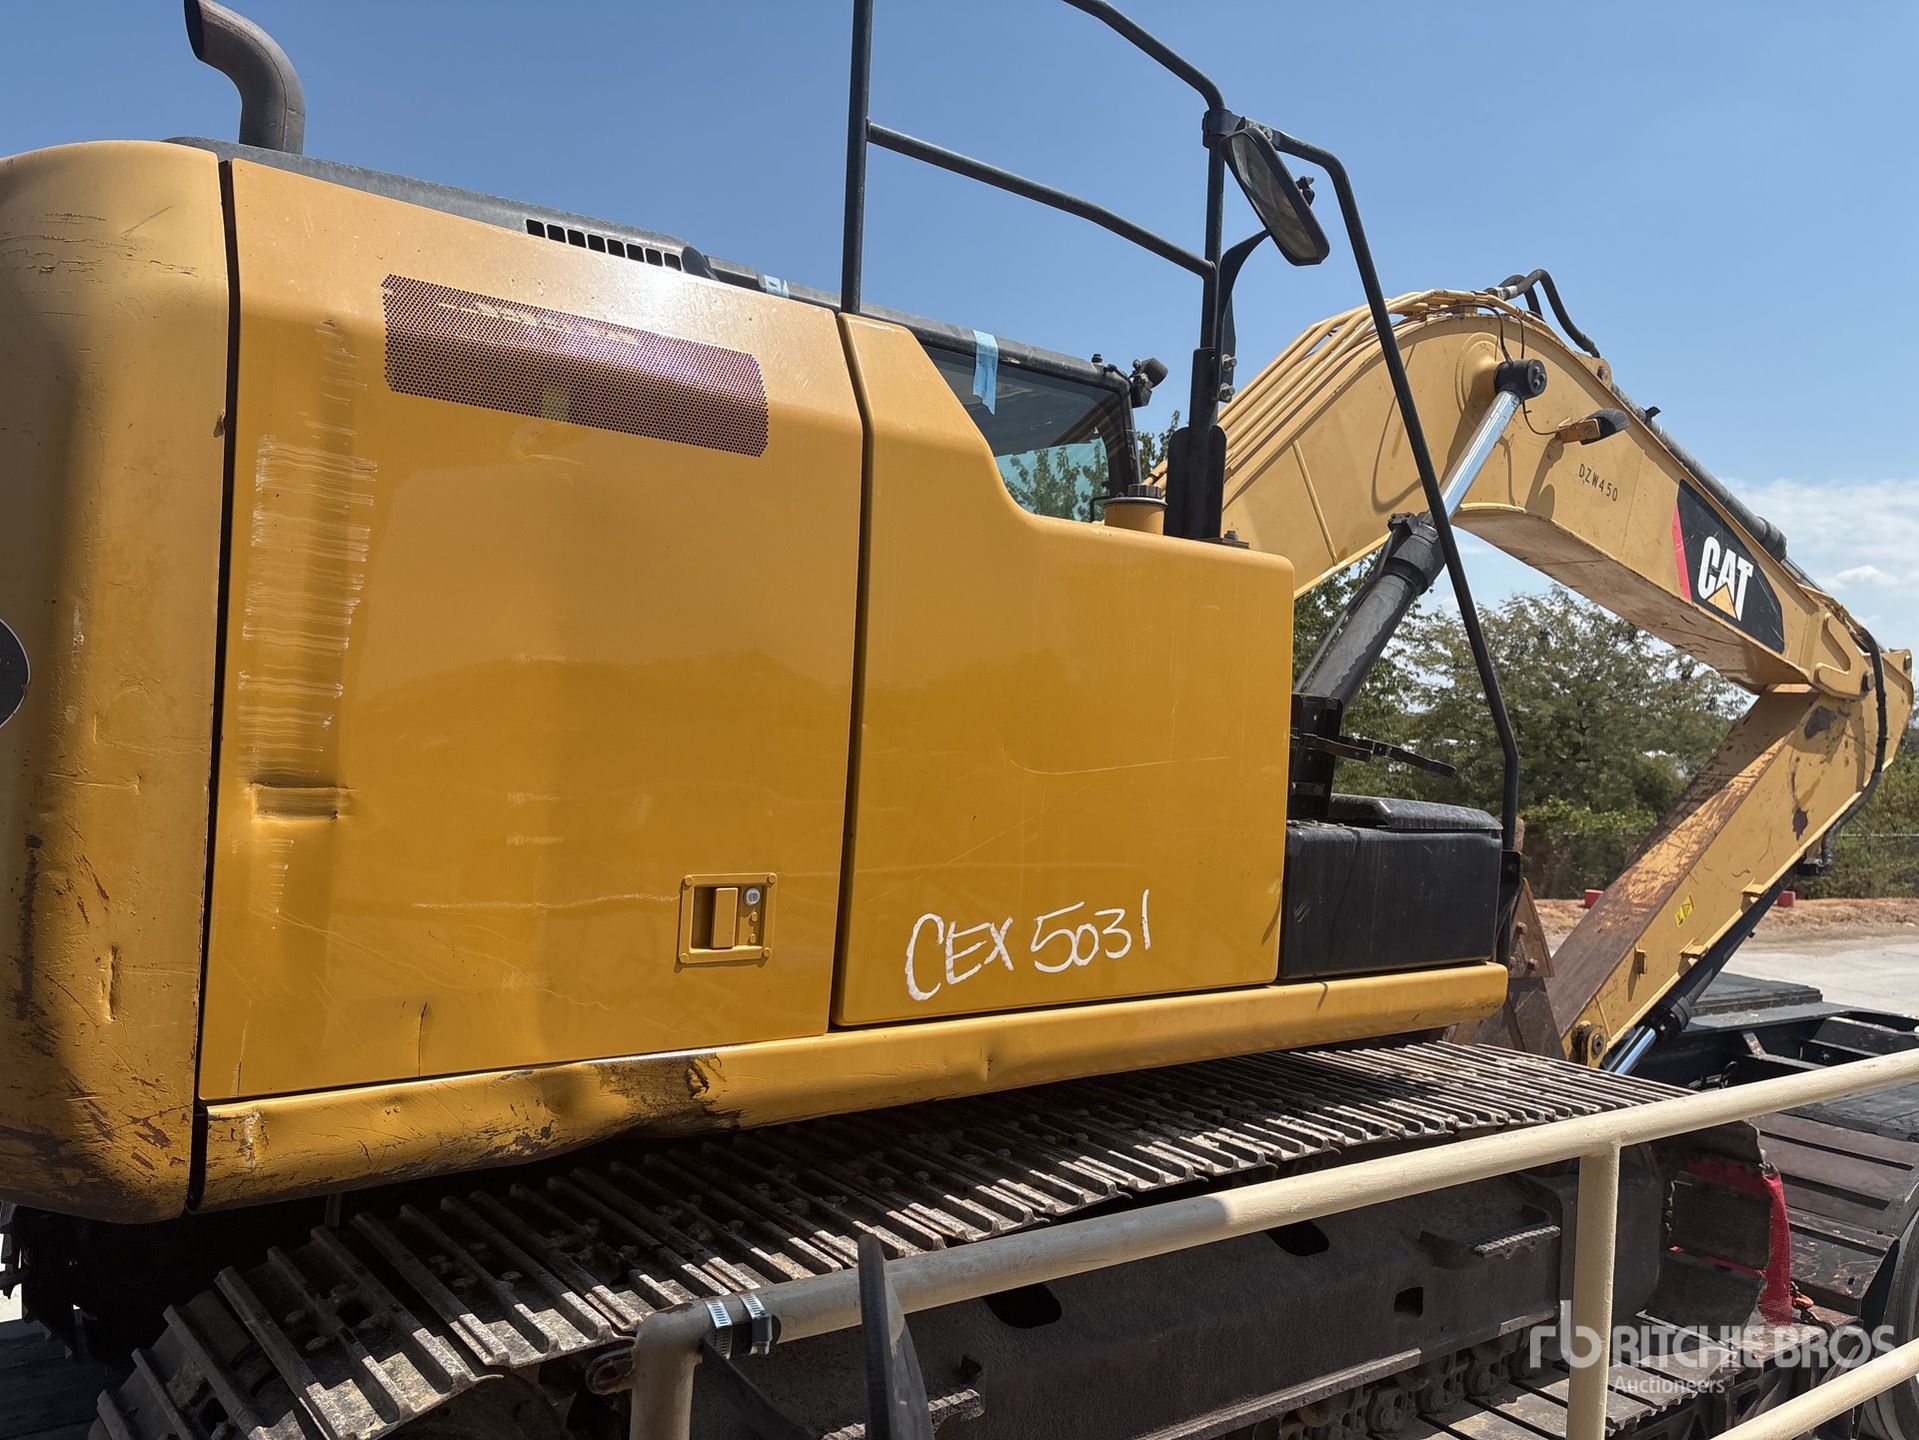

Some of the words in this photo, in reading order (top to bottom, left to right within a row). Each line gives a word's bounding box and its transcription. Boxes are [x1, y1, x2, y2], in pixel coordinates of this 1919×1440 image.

[1579, 463, 1618, 502] DZW450
[1698, 536, 1754, 621] CAT
[904, 913, 1014, 1001] CEX
[1030, 888, 1151, 973] 5031
